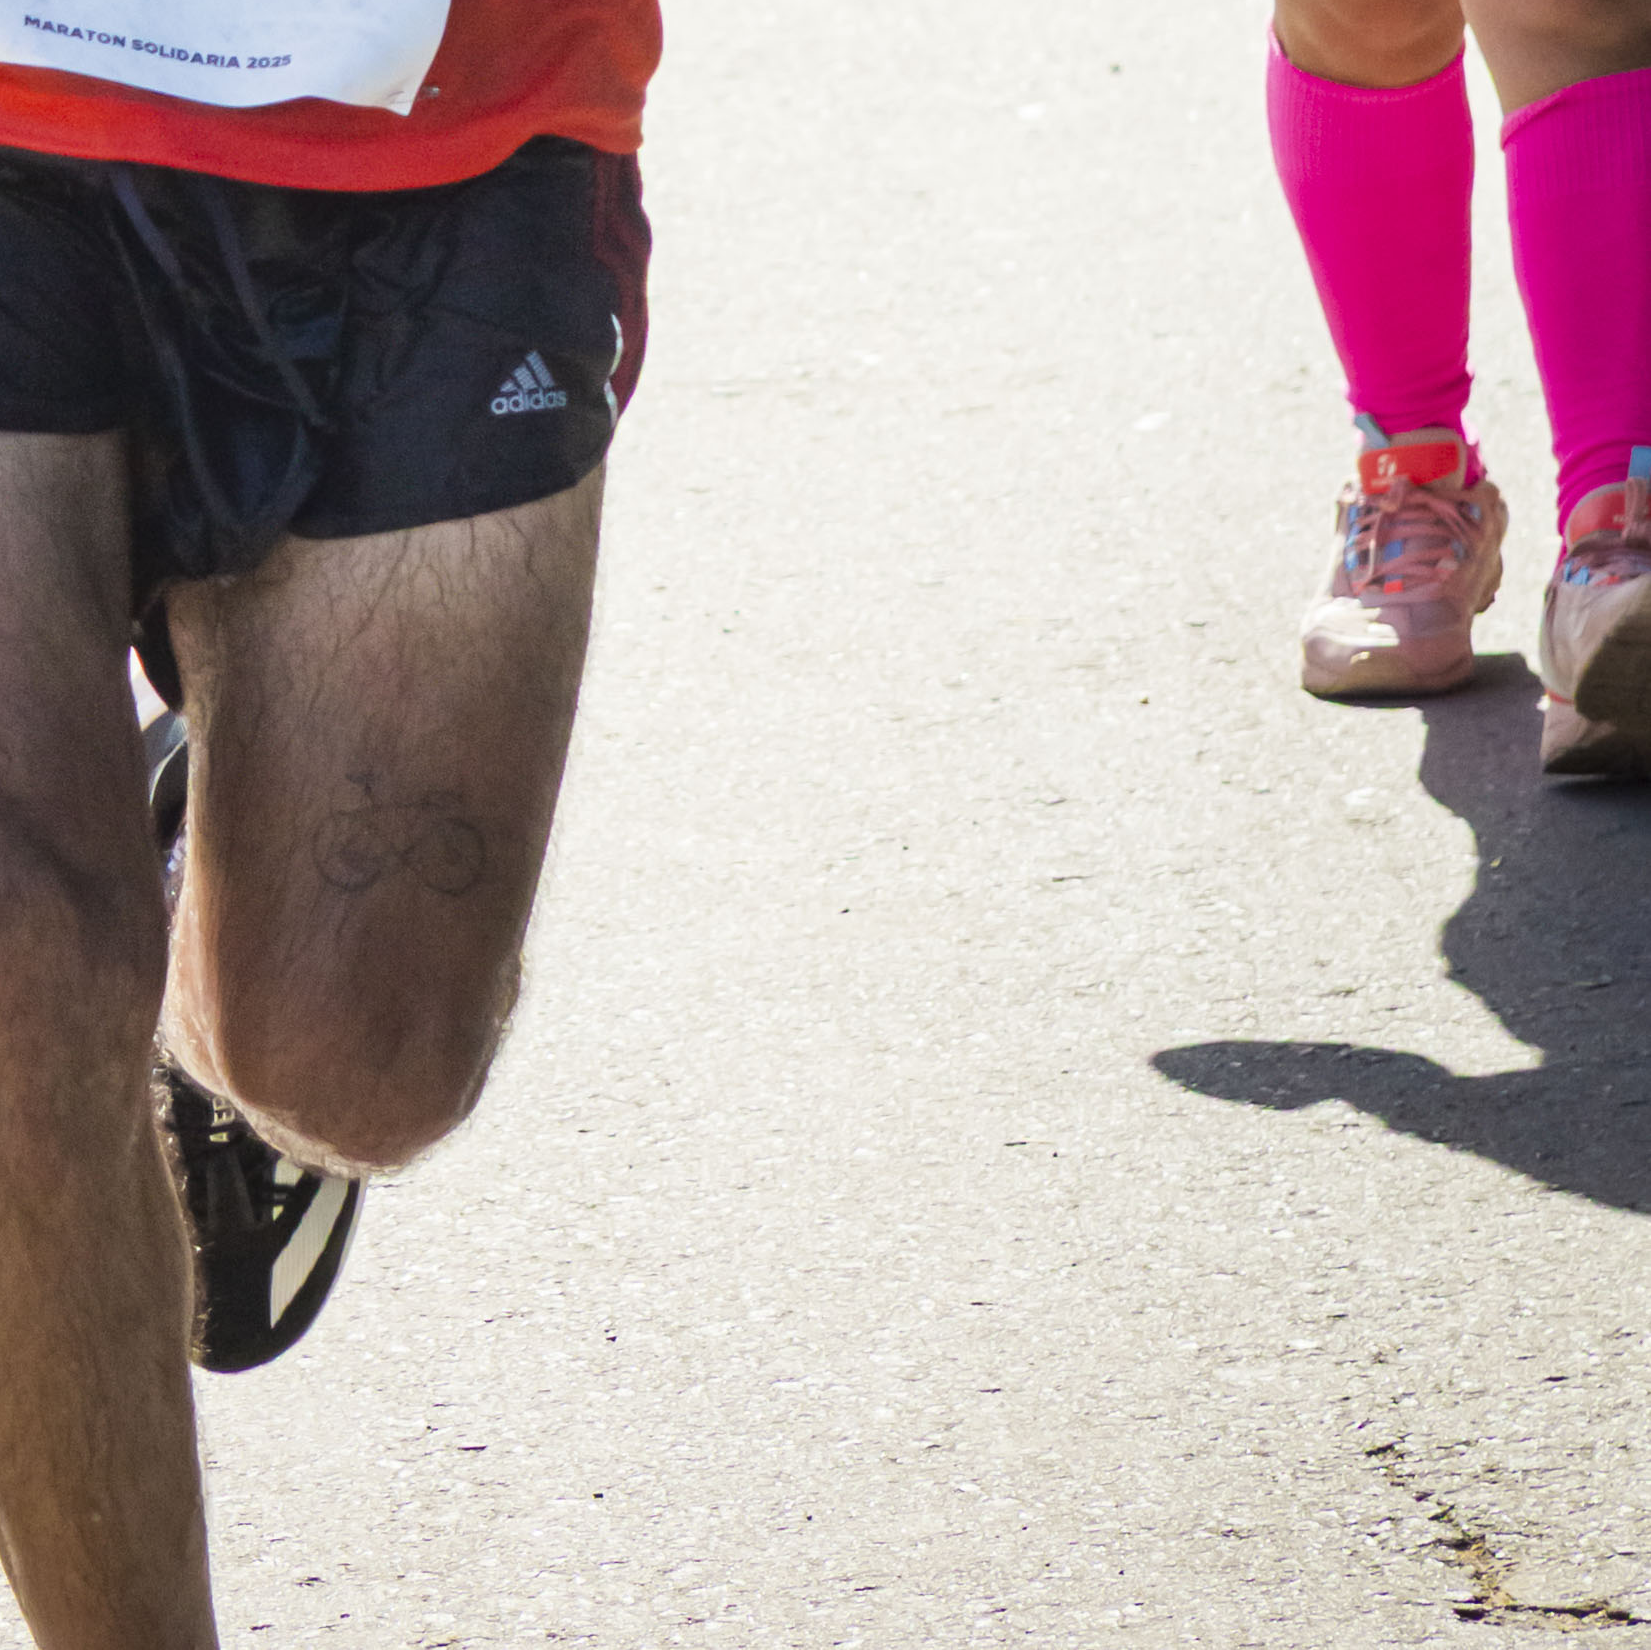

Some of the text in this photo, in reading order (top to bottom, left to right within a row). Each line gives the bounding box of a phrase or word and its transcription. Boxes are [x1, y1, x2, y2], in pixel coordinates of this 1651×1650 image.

[24, 15, 292, 70] MARATON SOLIDARIA 2025
[490, 388, 568, 416] adidas
